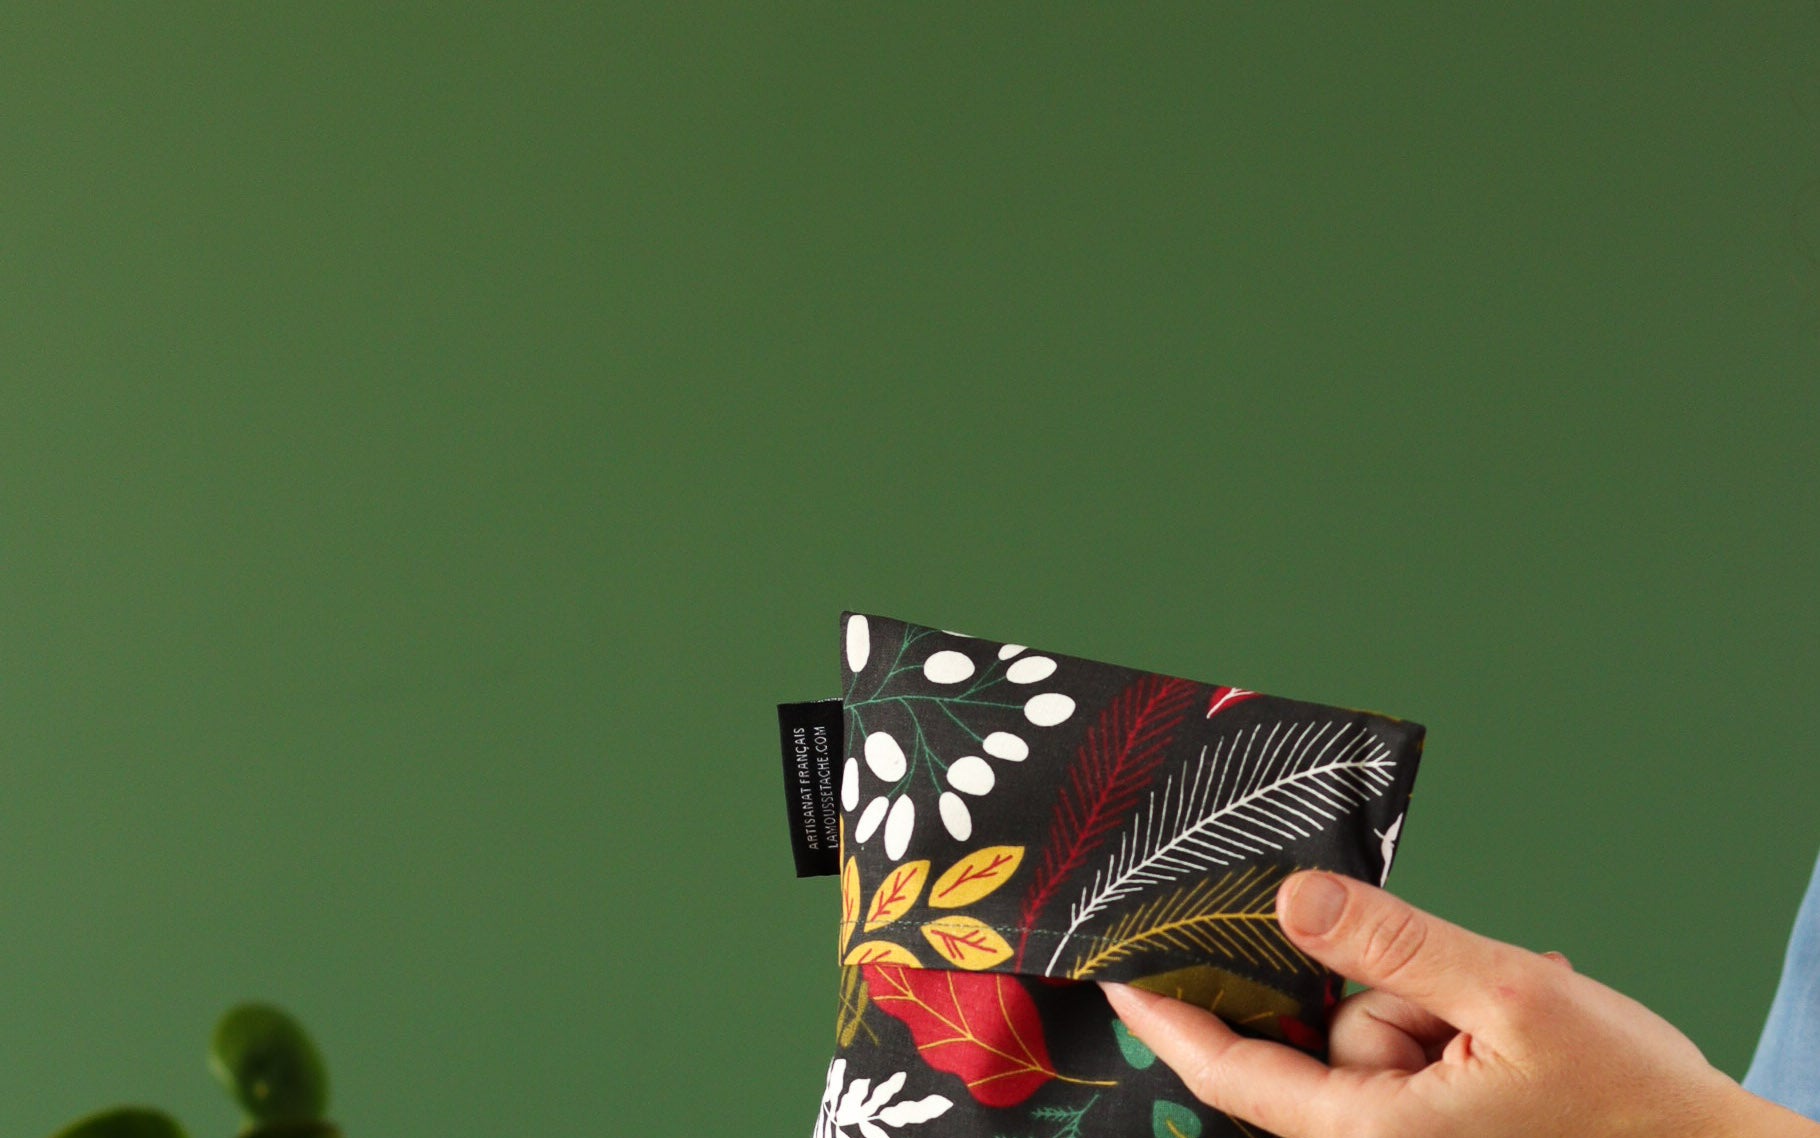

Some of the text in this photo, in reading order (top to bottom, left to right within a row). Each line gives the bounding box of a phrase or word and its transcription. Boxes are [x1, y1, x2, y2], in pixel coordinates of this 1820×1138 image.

[793, 727, 819, 850] ARTISANAT FRANÇAIS
[813, 726, 839, 849] LAMOUSSETACHE.COM
